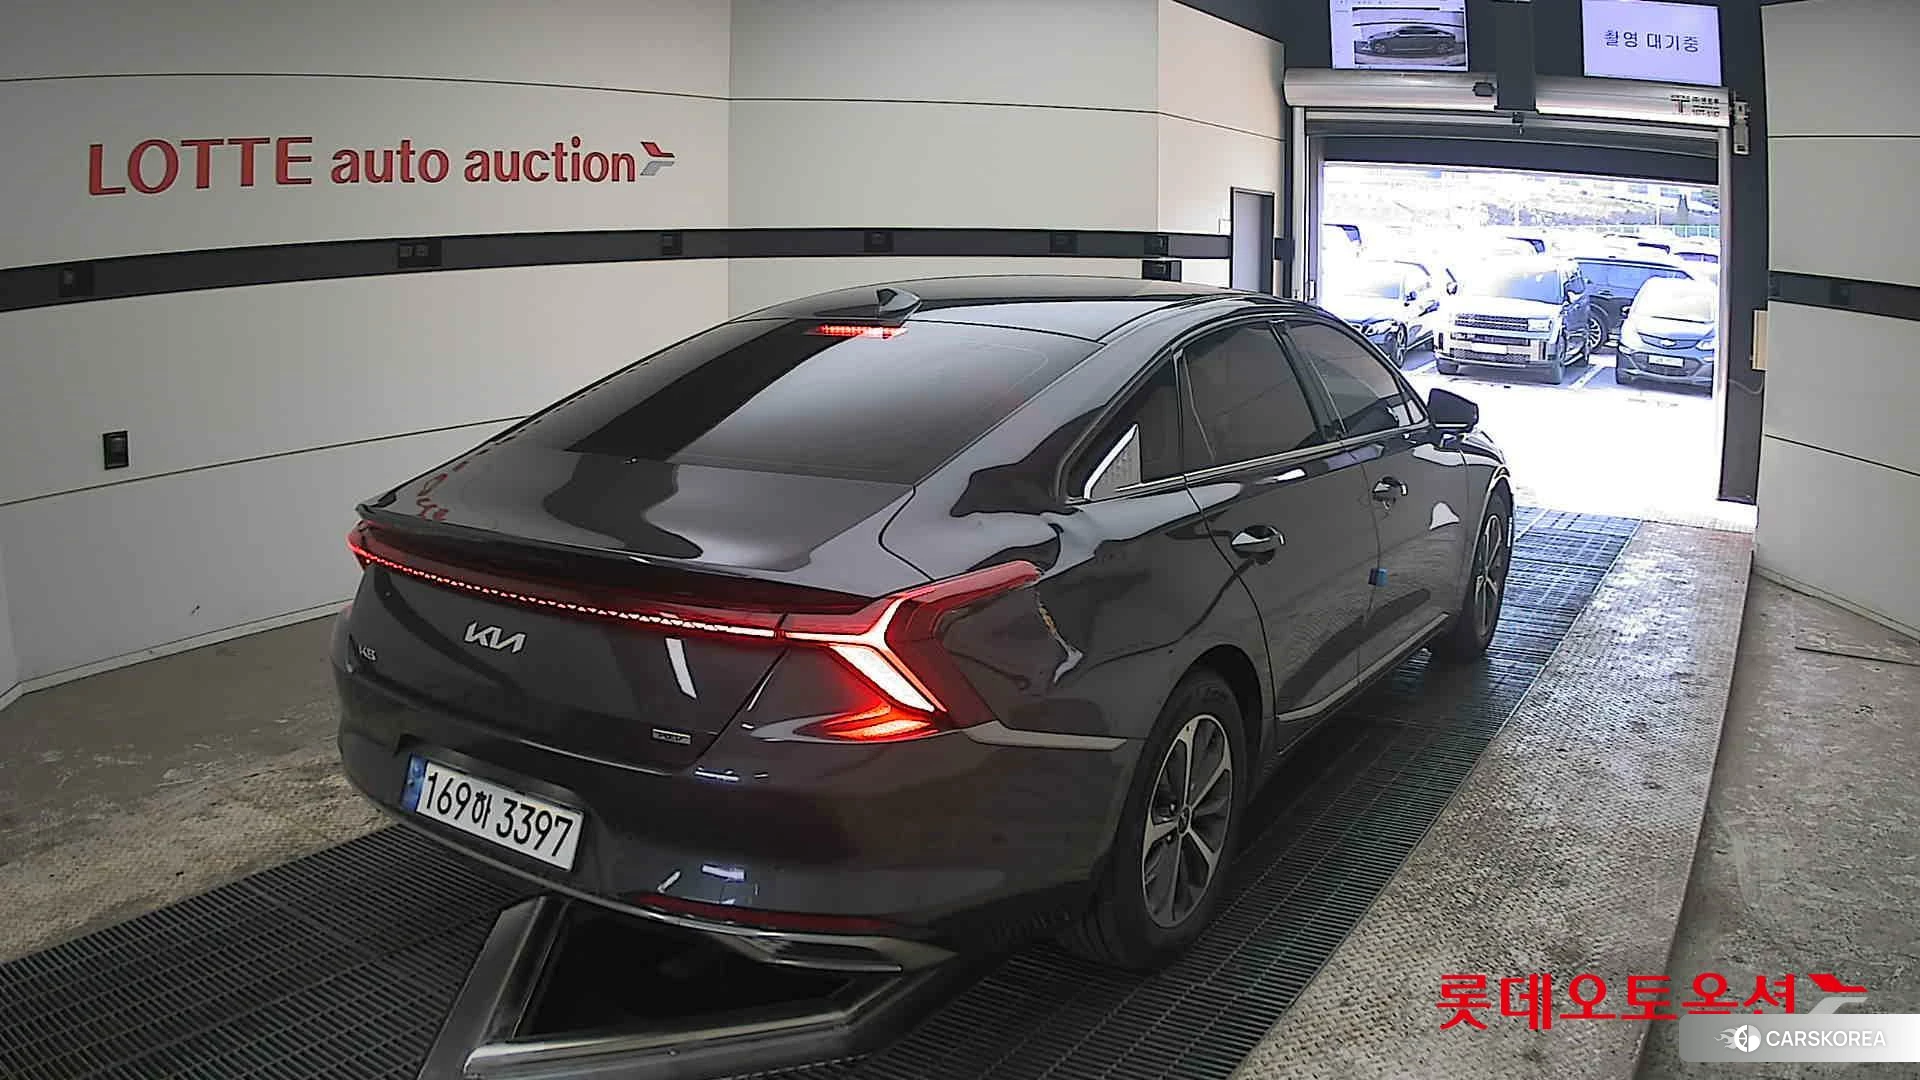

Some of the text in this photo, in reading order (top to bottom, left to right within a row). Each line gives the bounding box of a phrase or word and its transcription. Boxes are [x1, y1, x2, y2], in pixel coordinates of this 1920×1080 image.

[88, 134, 638, 196] LOTTE auto auction
[463, 620, 527, 655] KIA
[426, 771, 574, 857] 169하 3397
